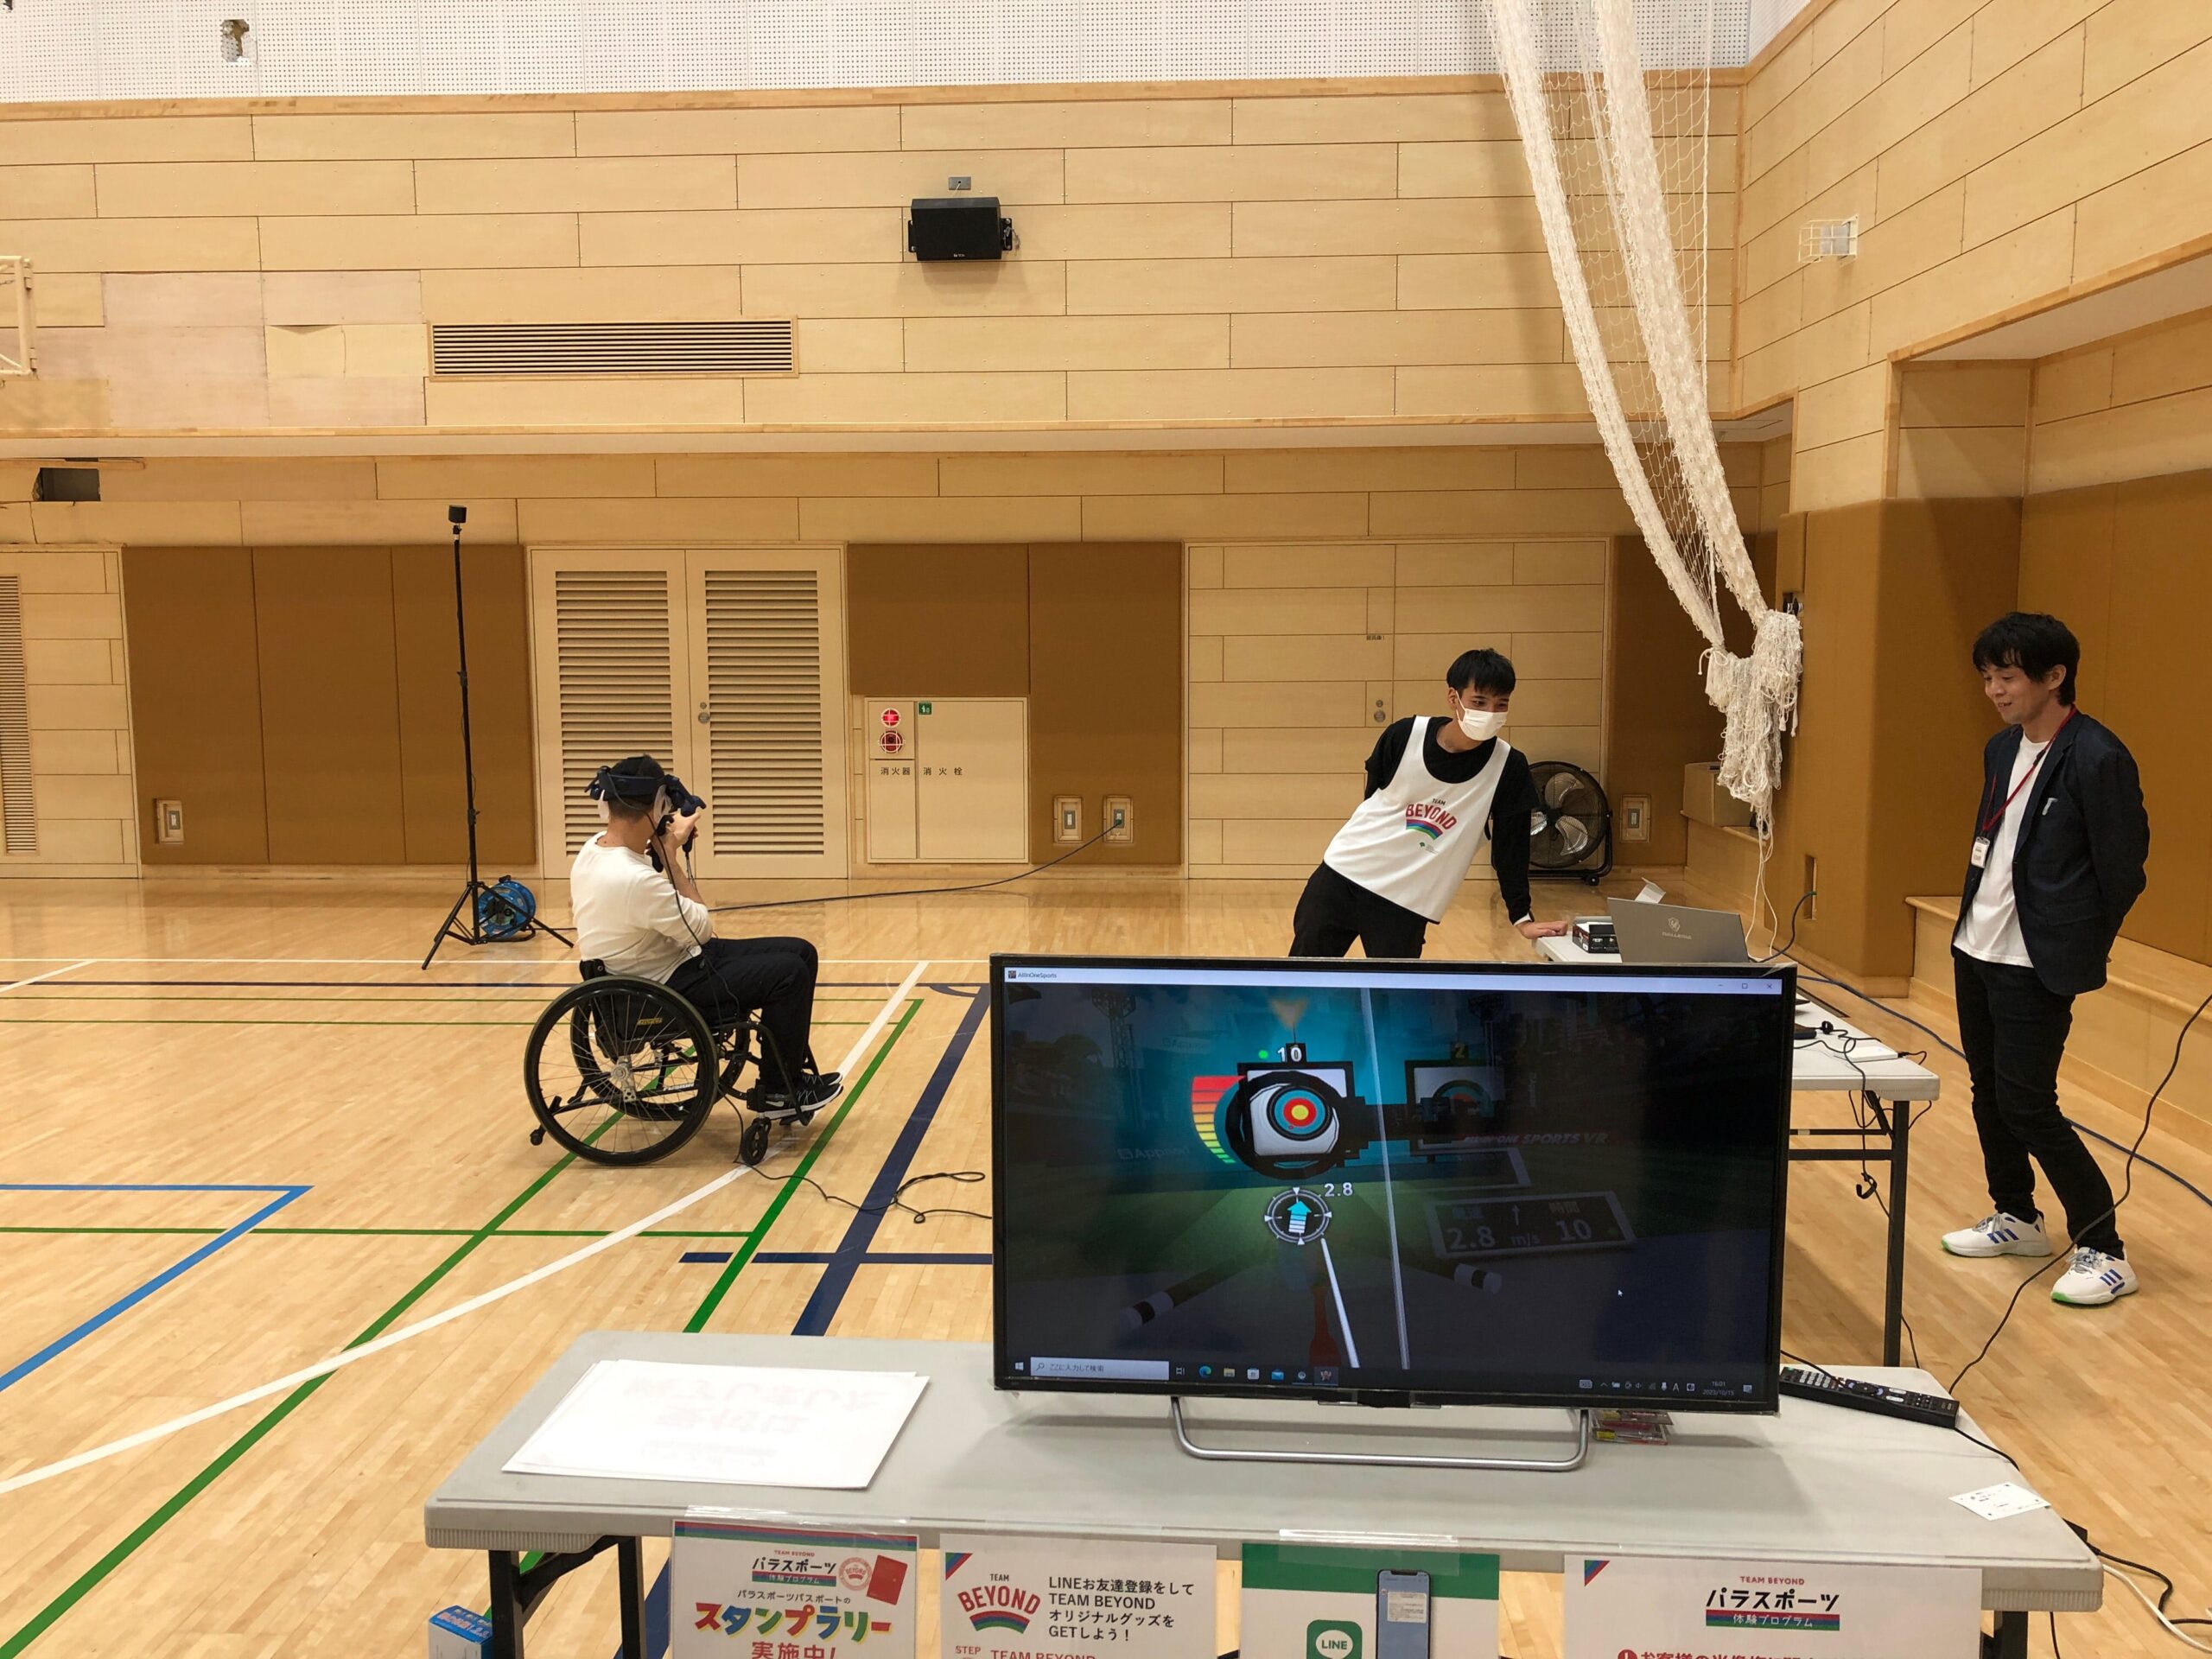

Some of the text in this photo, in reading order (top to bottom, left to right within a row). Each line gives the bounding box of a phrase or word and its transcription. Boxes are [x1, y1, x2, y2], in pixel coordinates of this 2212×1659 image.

[880, 766, 911, 776] 消火器
[923, 766, 963, 776] 消火栓
[1406, 804, 1457, 830] BEYOND
[1277, 1046, 1303, 1063] 10
[1324, 1183, 1352, 1198] 2.8
[1446, 1226, 1540, 1250] 2.8 m/s
[1555, 1219, 1592, 1242] 10
[752, 1557, 836, 1574] パラスポーツ
[1049, 1577, 1194, 1595] LINEお友達登録をして
[1768, 1577, 1805, 1586] BEYOND
[737, 1589, 851, 1605] パラスポーツパスポートの
[957, 1585, 1041, 1615] BEYOND
[1049, 1592, 1155, 1610] TEAM BEYOND
[1705, 1587, 1840, 1612] パラスポーツ
[695, 1603, 893, 1643] スタンプラリー
[1049, 1610, 1175, 1628] オリジナルグッズを
[1732, 1613, 1813, 1628] 体験プログラム
[955, 1645, 982, 1655] STEP
[1321, 1639, 1348, 1650] LINE
[991, 1649, 1031, 1659] TEAM
